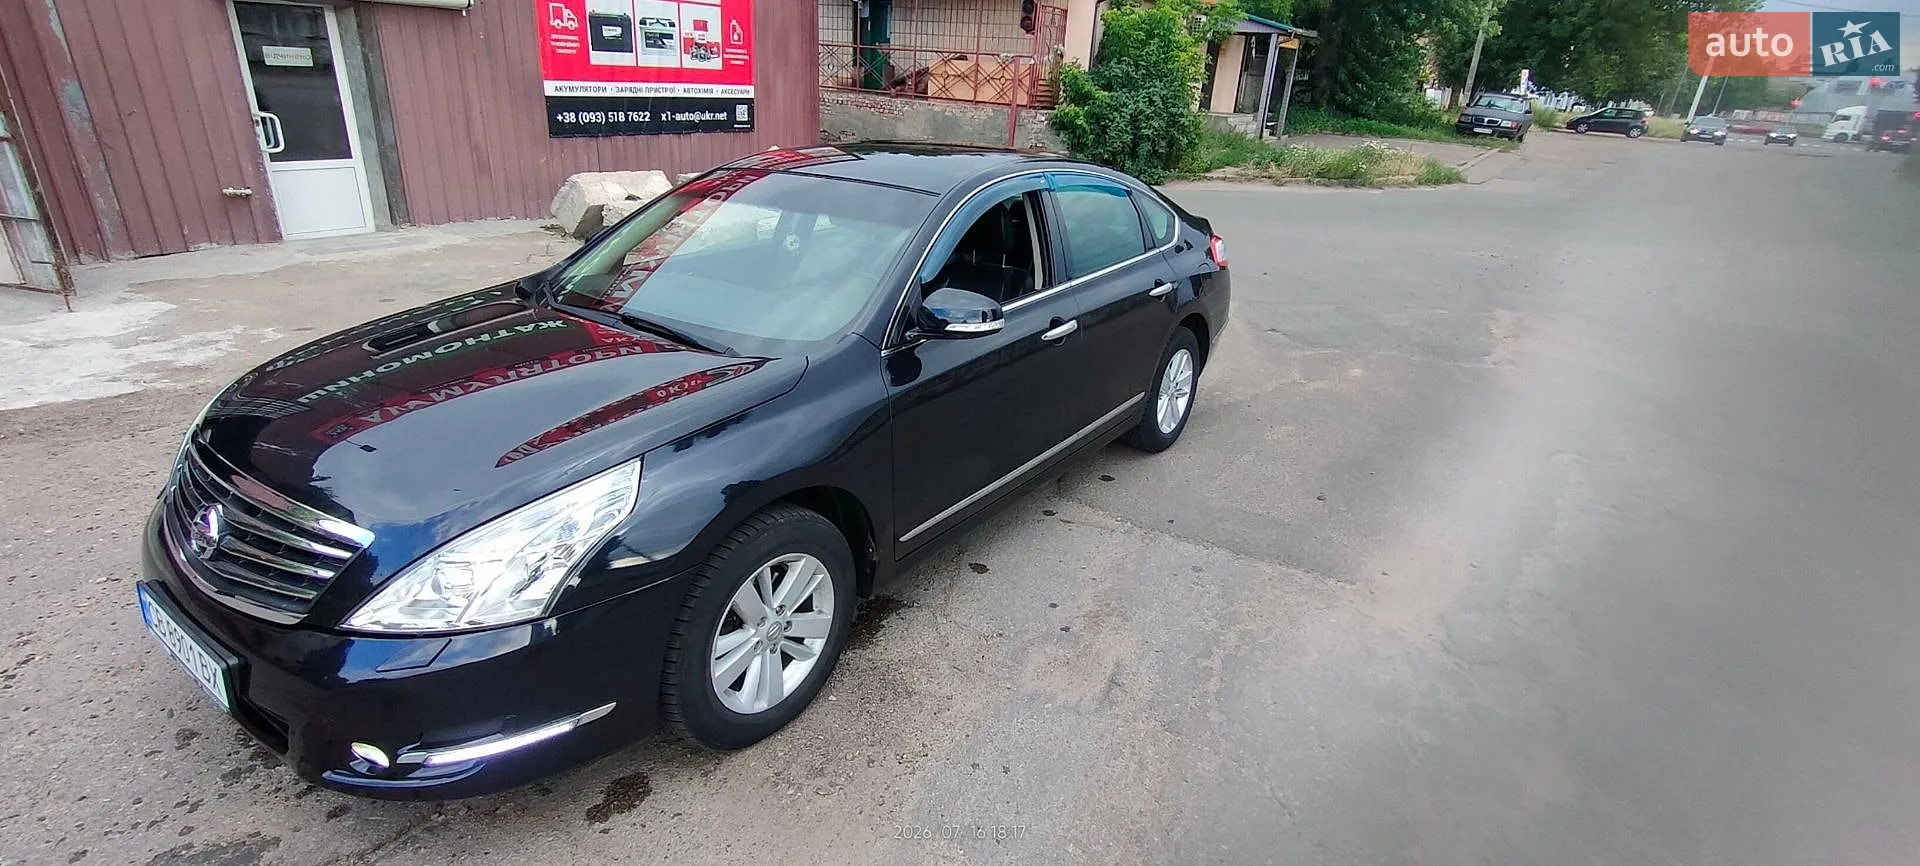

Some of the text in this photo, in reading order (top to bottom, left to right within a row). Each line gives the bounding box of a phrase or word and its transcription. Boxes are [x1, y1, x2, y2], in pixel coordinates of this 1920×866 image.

[554, 86, 607, 94] АКУМУЛЯТОРИ
[645, 87, 676, 95] ПРИСТРОЇ
[556, 111, 728, 125] +38 (093) 518 7622 x1-auto@ukr.net
